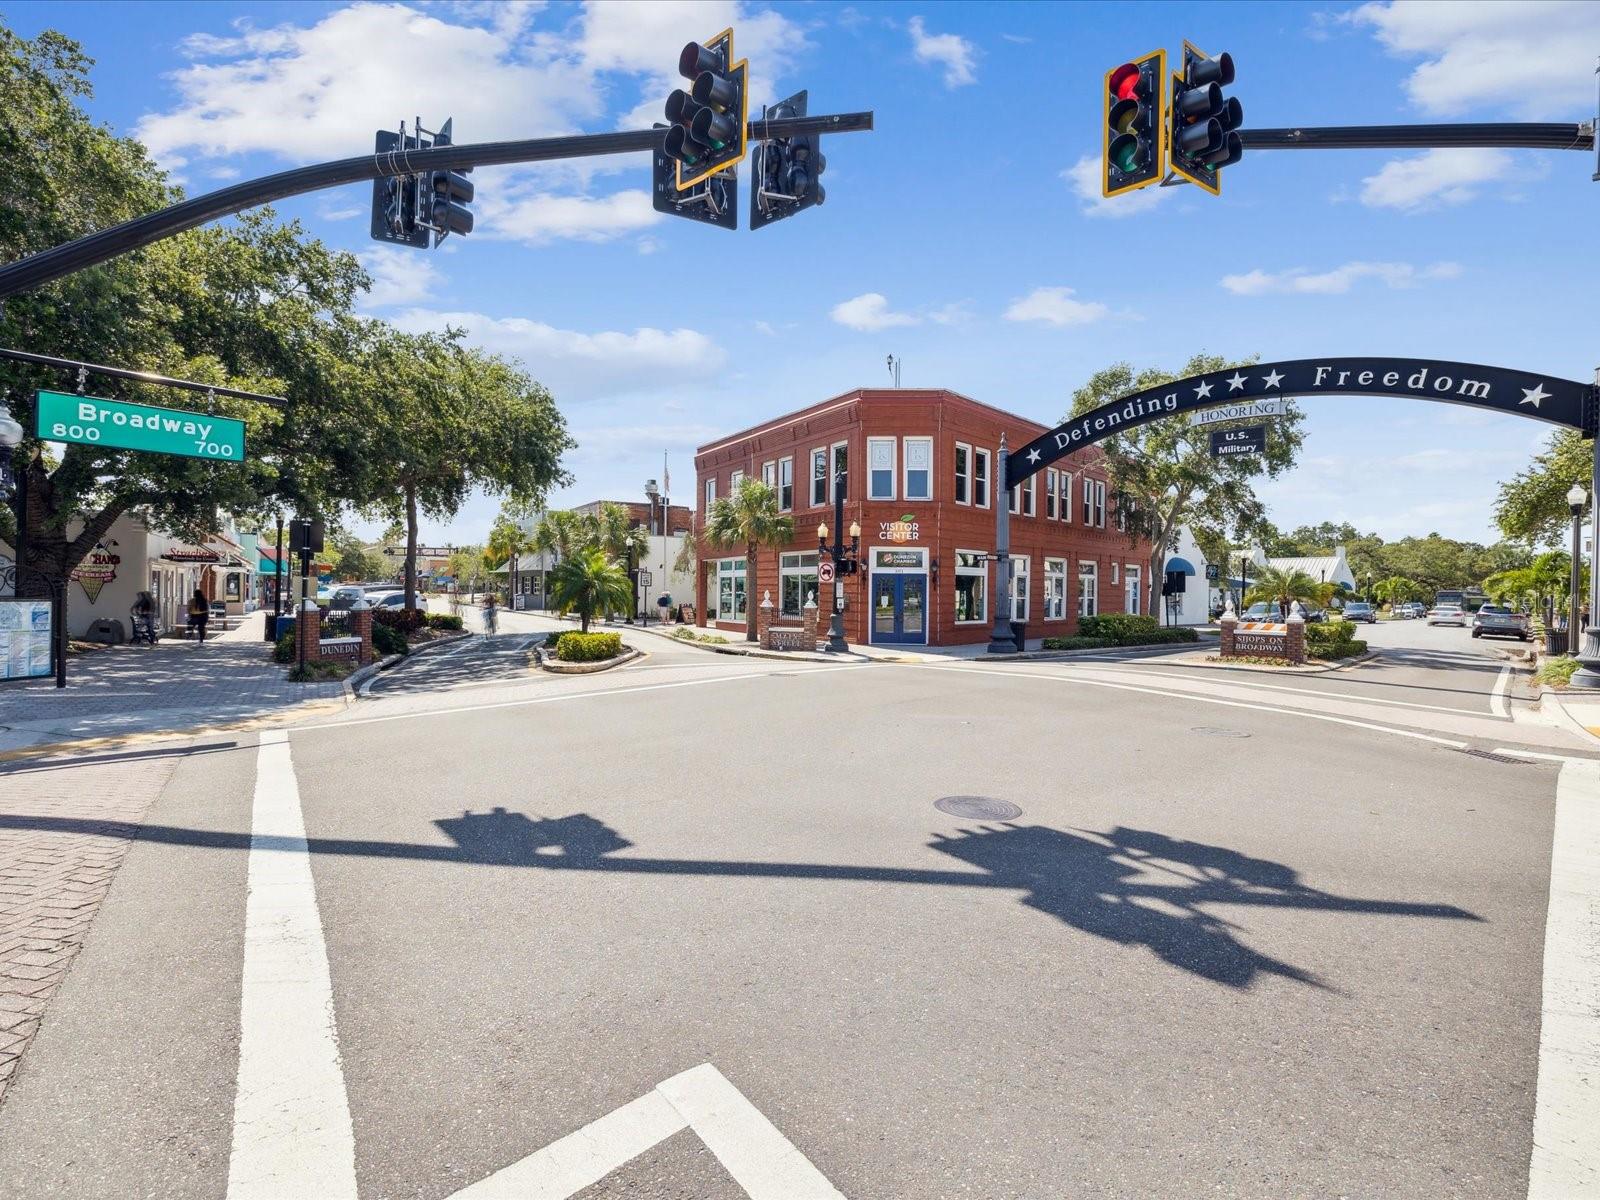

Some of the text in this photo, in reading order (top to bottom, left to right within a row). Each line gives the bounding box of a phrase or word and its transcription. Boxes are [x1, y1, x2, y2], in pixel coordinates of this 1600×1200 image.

[1054, 366, 1491, 449] Defending Freedom
[1201, 403, 1274, 422] HONORING
[78, 402, 212, 440] Broadway
[52, 423, 233, 457] 800 700
[1225, 431, 1249, 441] U.S.
[1218, 445, 1257, 454] Military
[880, 522, 919, 531] VISITOR
[879, 531, 919, 540] CENTER
[321, 644, 360, 655] DUNEDIN
[1235, 643, 1284, 652] BROADWAY
